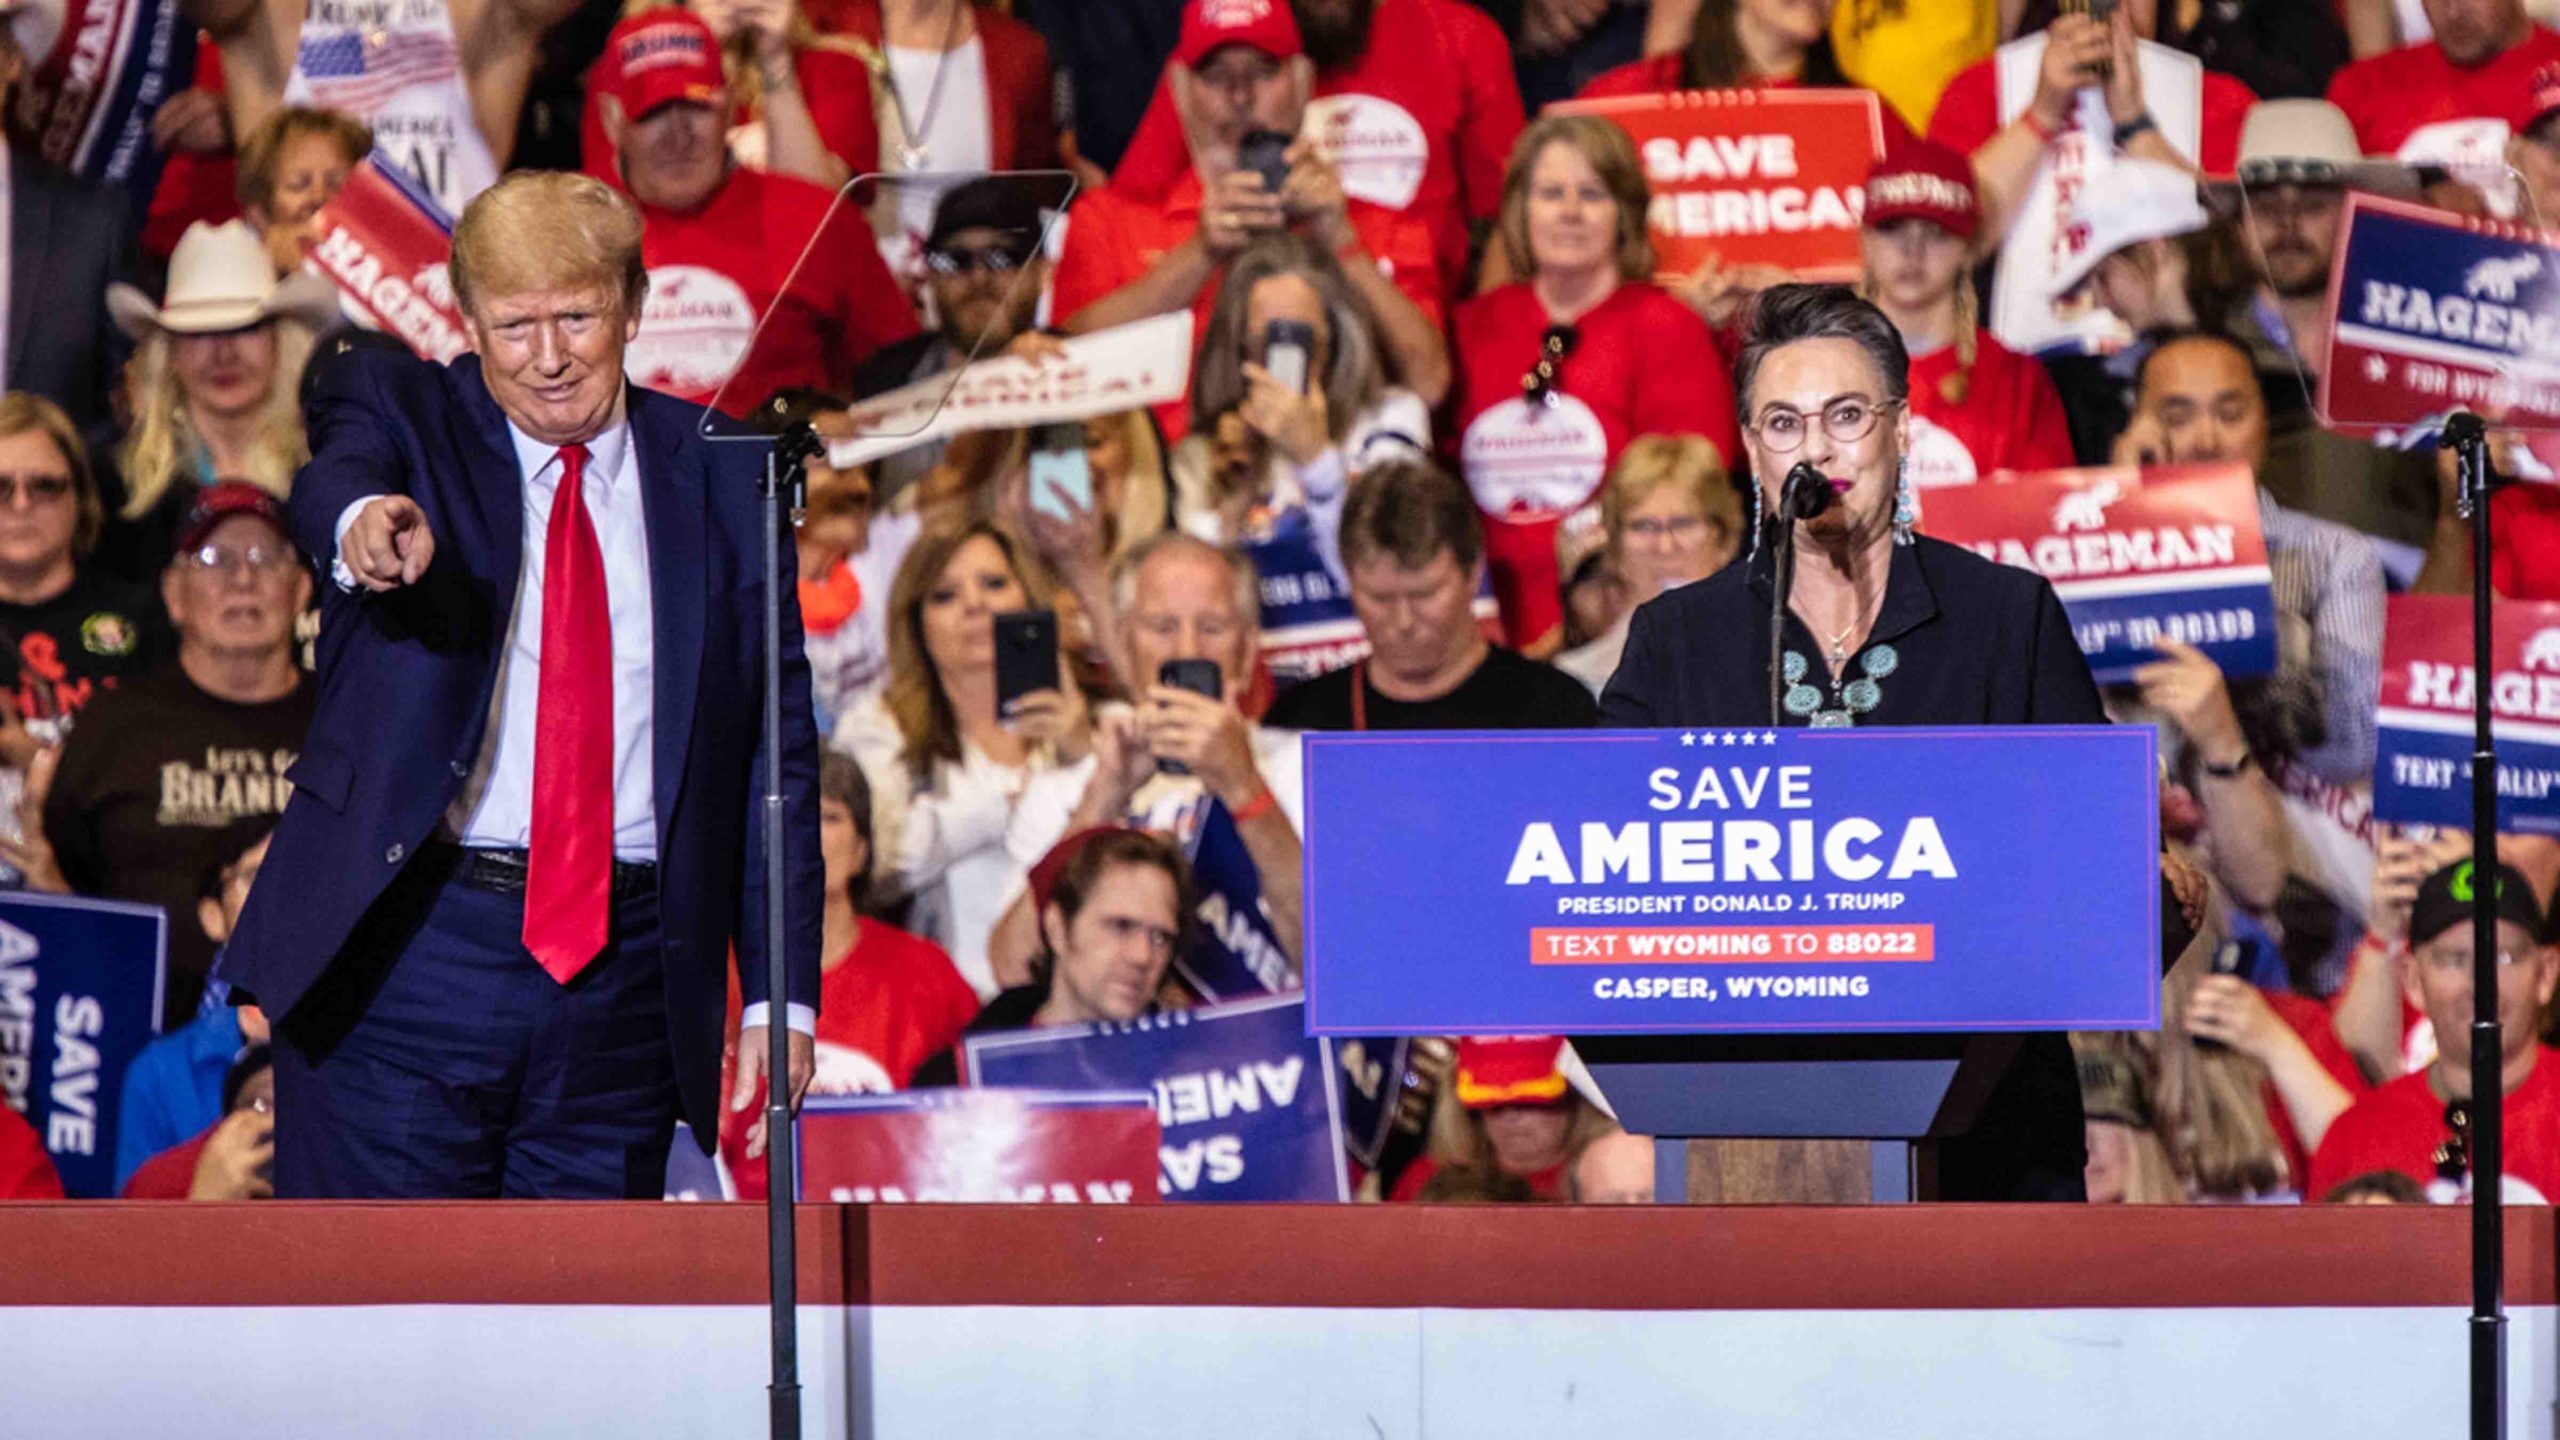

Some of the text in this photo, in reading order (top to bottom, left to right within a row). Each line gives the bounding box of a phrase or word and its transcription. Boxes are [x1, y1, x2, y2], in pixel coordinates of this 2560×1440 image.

[1642, 134, 1798, 182] SAVE
[1647, 765, 1814, 811] SAVE
[2392, 753, 2455, 790] TEXT
[1504, 816, 1959, 885] AMERICA
[1557, 892, 1905, 916] PRESIDENT DONALD J. TRUMP
[1545, 931, 1917, 958] TEXT WYOMING TO 88022
[1593, 974, 1871, 1002] CASPER, WYOMING
[48, 991, 104, 1156] SAVE
